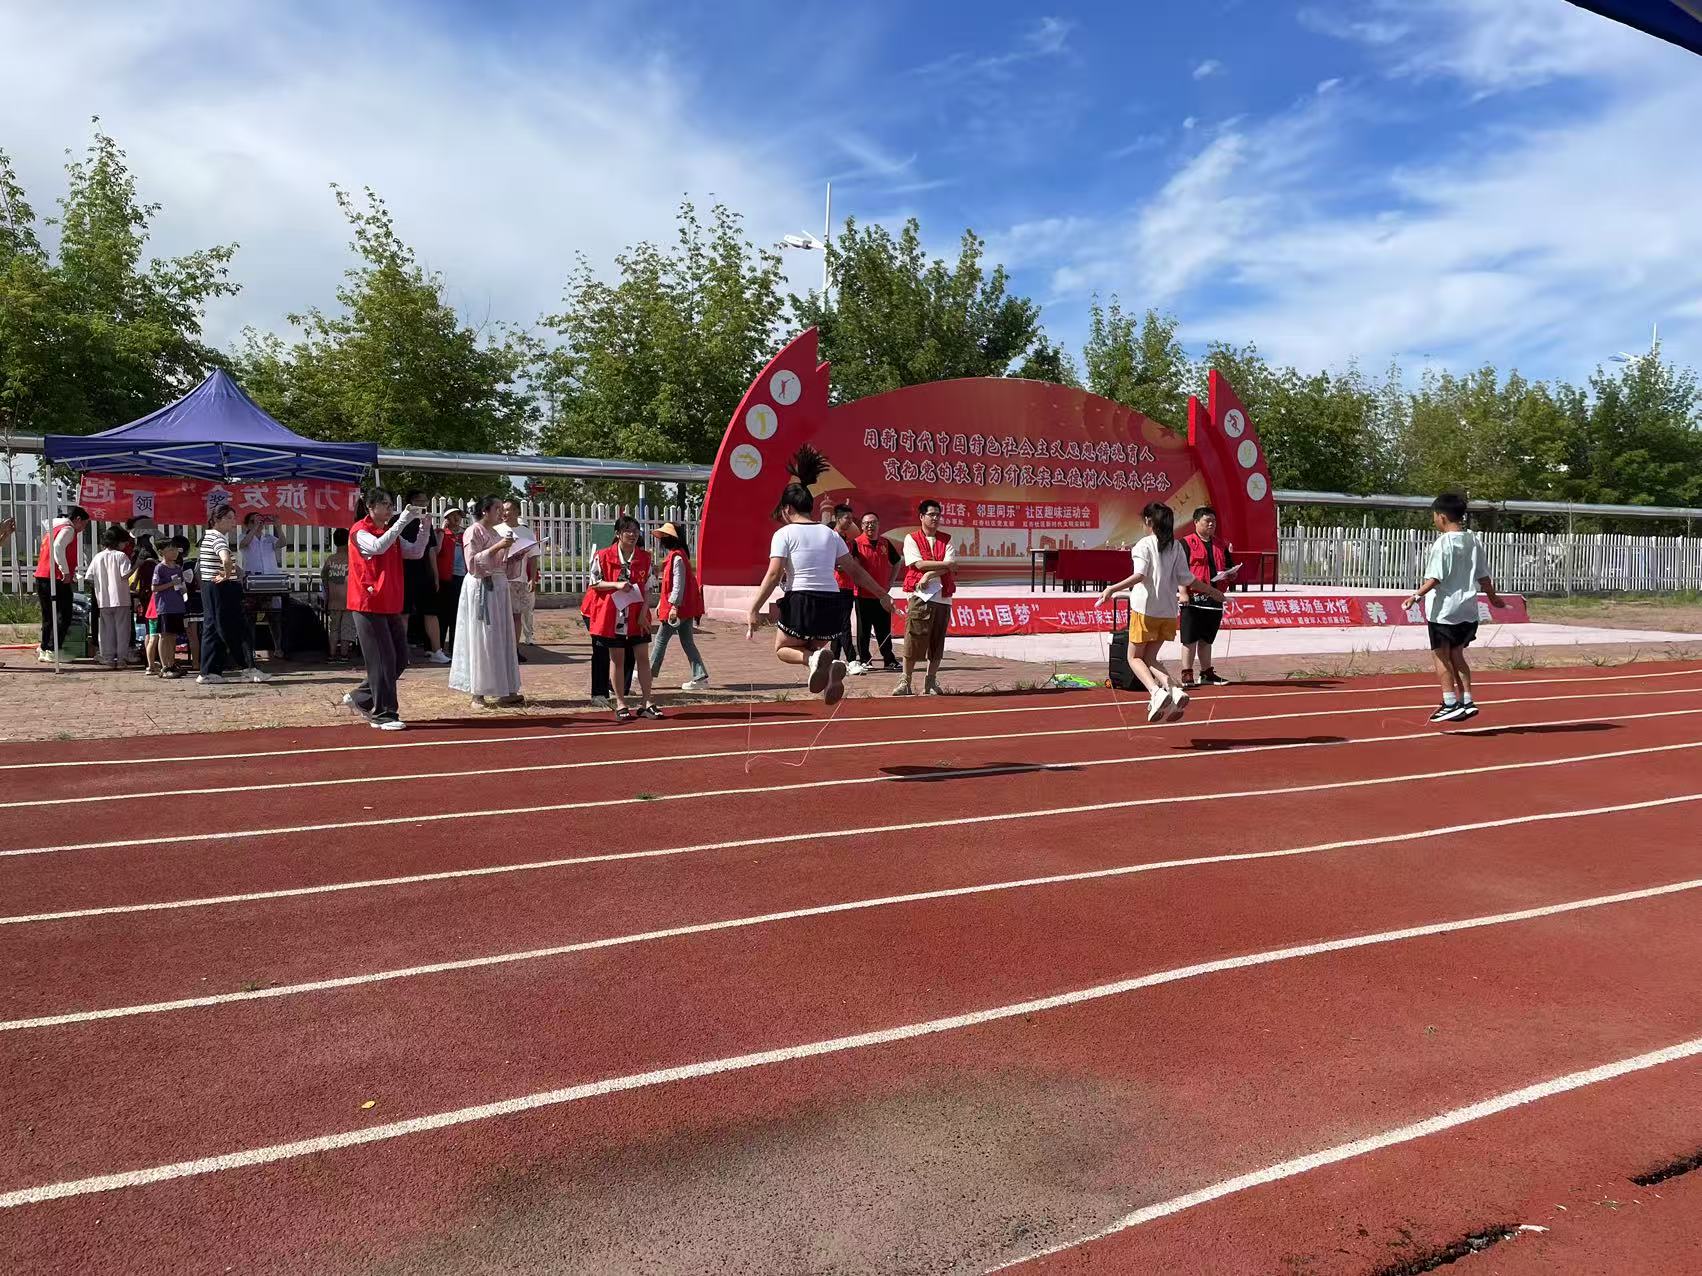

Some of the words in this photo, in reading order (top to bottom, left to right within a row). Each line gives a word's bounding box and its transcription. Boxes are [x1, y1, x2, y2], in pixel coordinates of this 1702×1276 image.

[863, 428, 1155, 465] 用新时代中国特色社会主义思想铸魂育人
[883, 457, 1171, 492] 贯彻党的教育方针落实立德树人根本任务
[135, 495, 153, 511] 领
[1025, 505, 1091, 519] 社区趣味运动会
[1262, 599, 1350, 614] 趣味赛场鱼水情
[1365, 601, 1388, 624] 养
